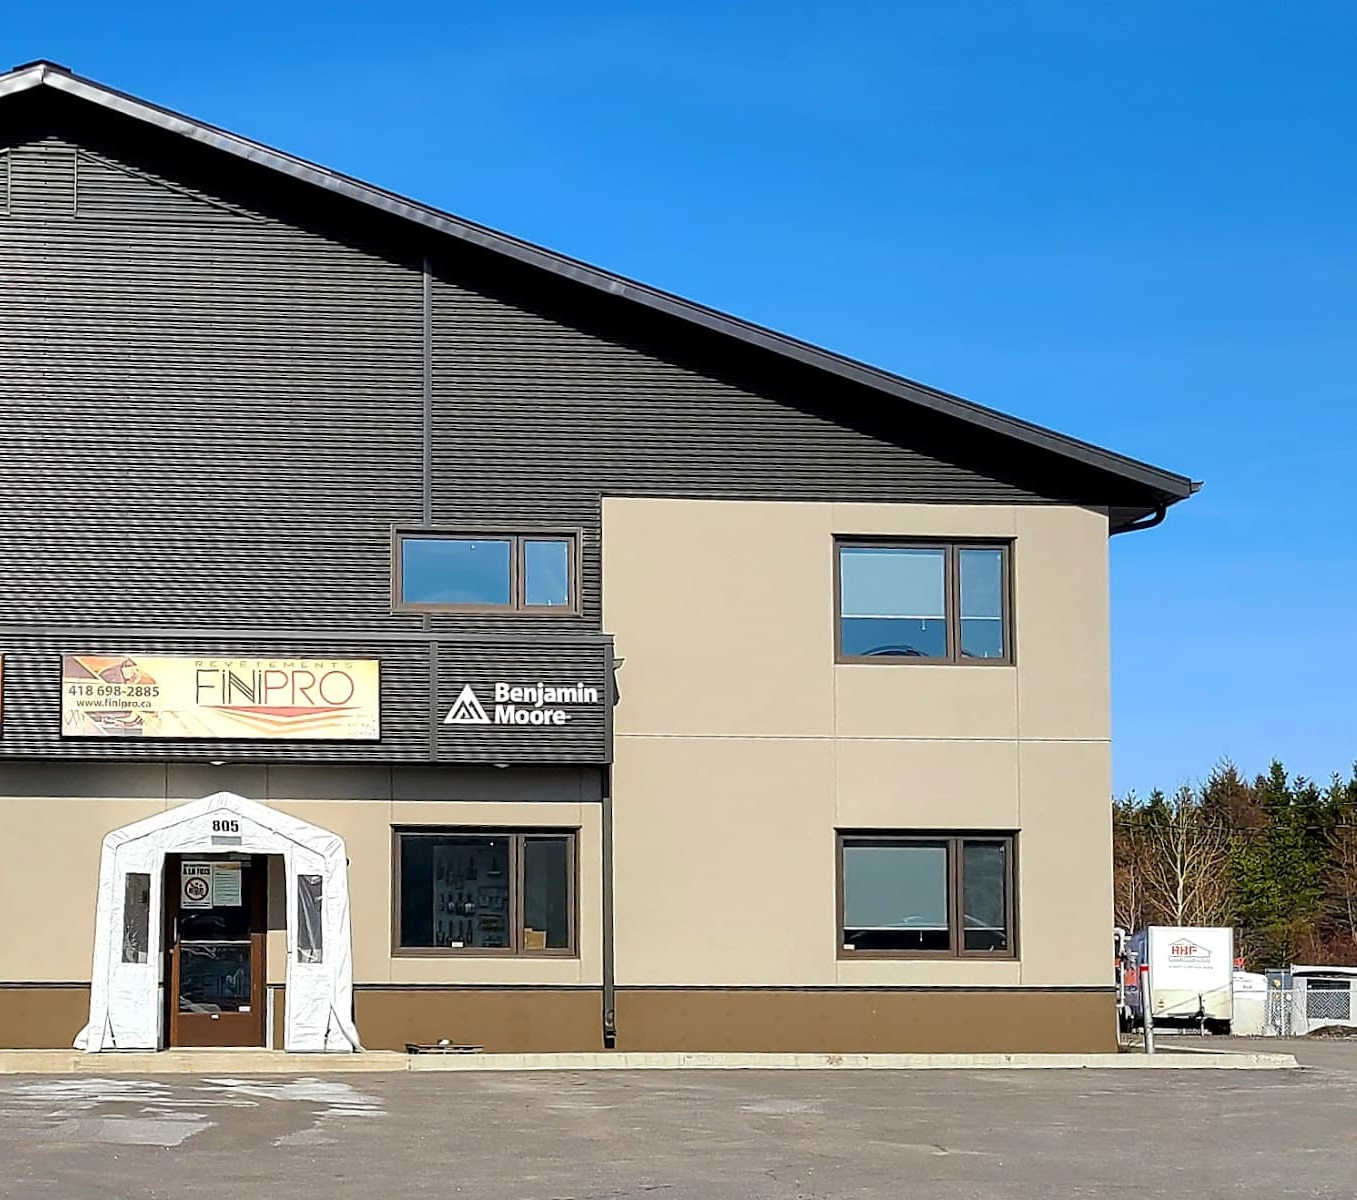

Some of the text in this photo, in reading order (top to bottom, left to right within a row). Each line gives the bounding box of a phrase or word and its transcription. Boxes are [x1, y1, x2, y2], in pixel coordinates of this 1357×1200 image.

[68, 685, 160, 697] 418 698-2885
[495, 682, 598, 707] Benjamin
[76, 698, 152, 709] www.finipro.ca
[495, 705, 567, 725] Moore
[212, 820, 239, 832] 805
